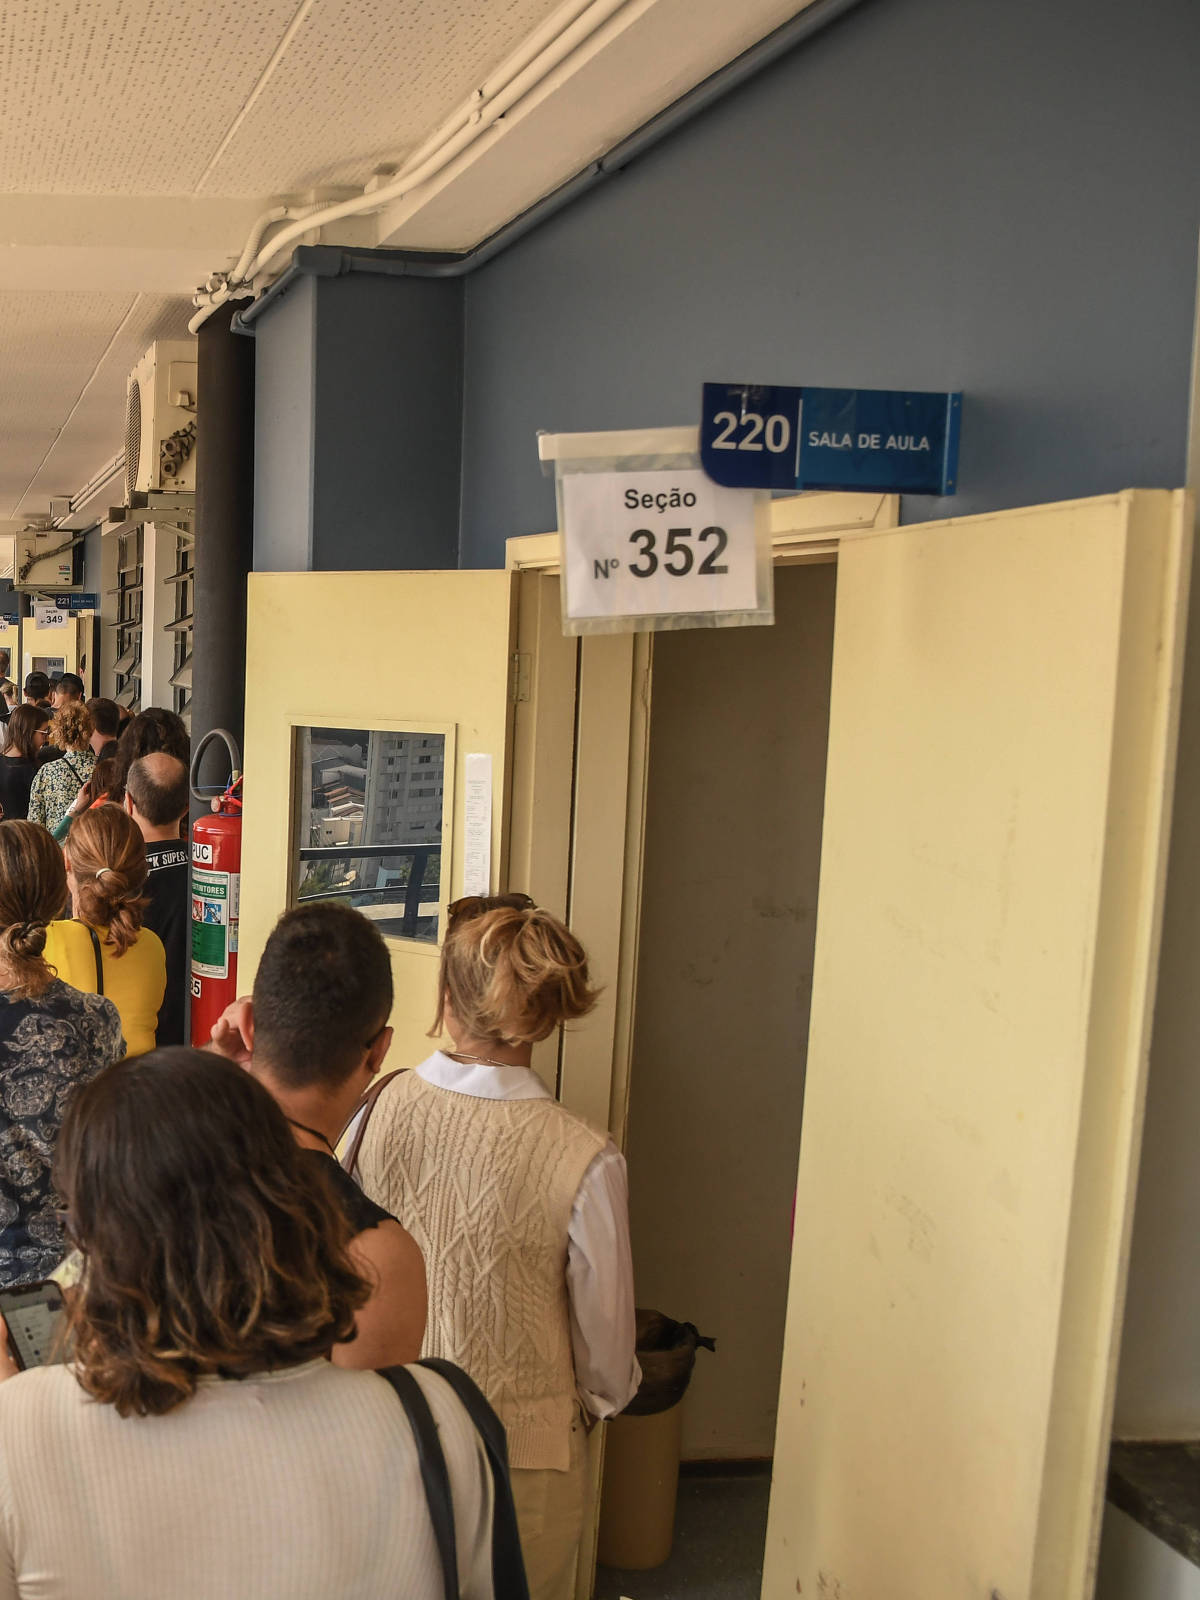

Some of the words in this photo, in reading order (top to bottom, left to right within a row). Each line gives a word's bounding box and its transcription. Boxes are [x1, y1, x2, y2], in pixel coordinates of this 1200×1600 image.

[711, 411, 790, 453] 220
[808, 431, 851, 448] SALA
[858, 433, 881, 449] DE
[885, 435, 930, 451] AULA
[624, 487, 697, 514] Seção
[628, 526, 729, 578] 352
[46, 615, 63, 624] 349
